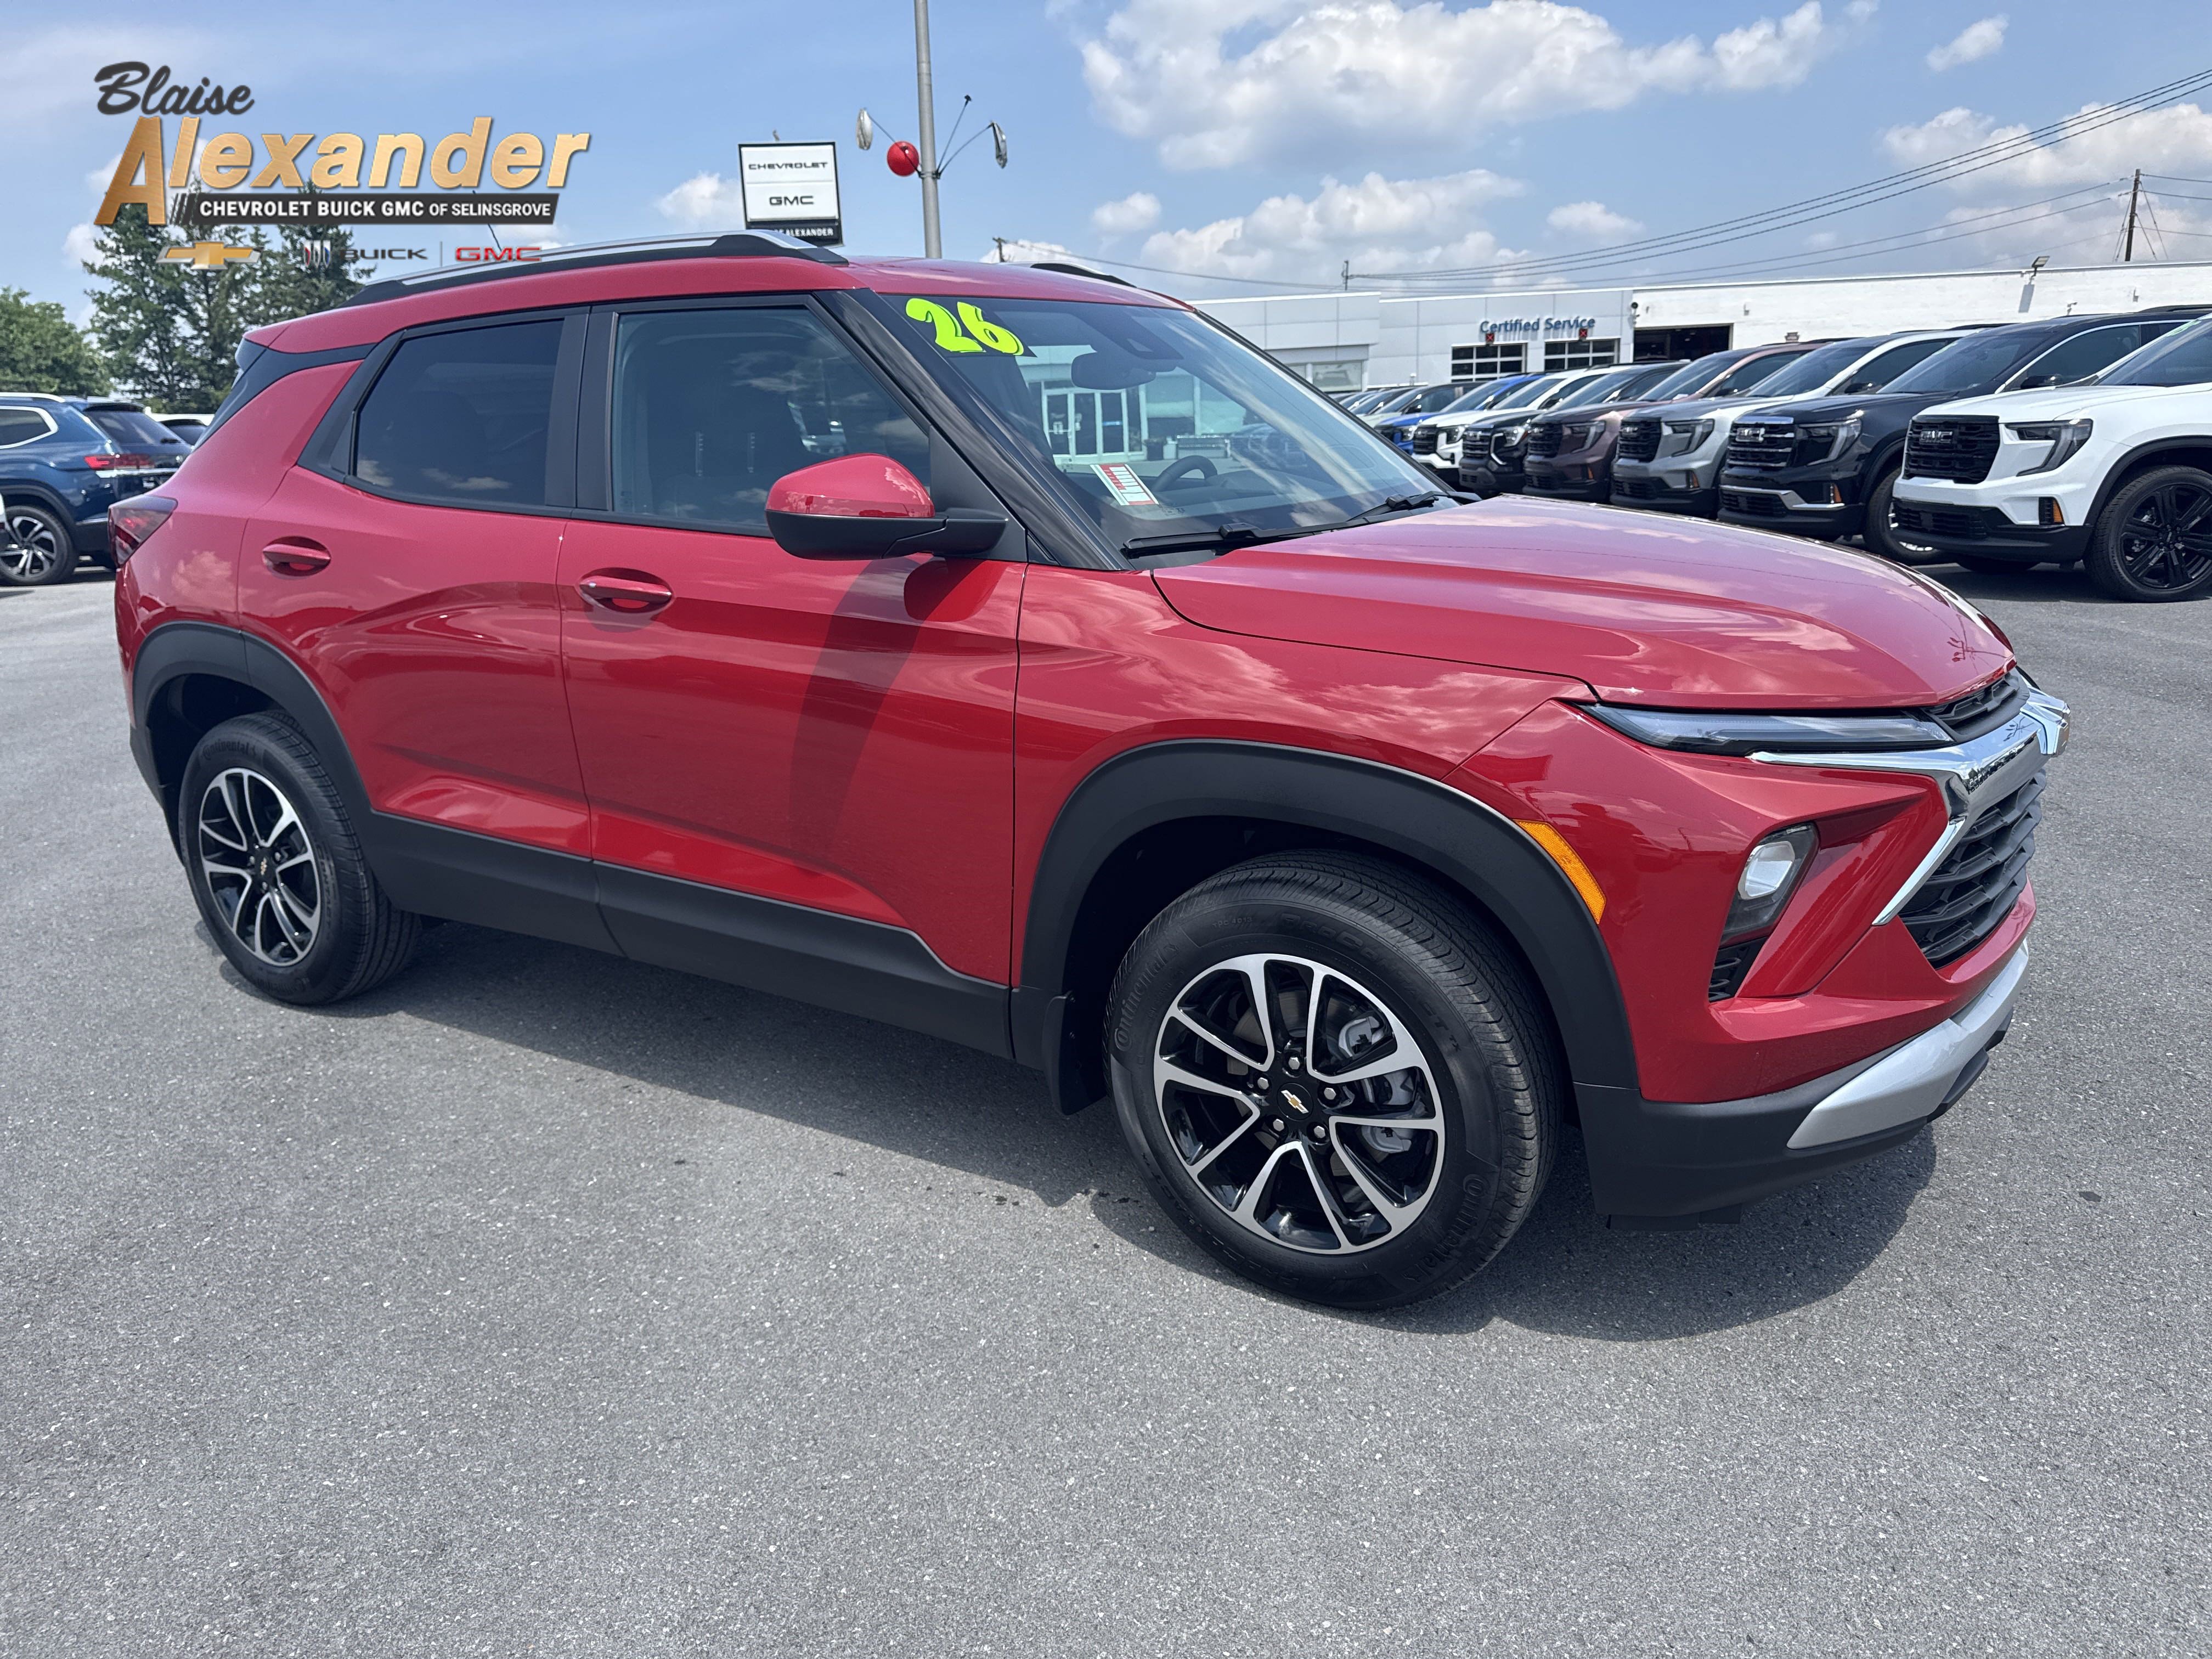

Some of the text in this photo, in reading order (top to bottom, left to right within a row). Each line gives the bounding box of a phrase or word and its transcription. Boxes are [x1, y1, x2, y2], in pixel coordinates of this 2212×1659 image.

[748, 162, 828, 170] CHEVROLET
[769, 195, 814, 206] GMC
[786, 227, 834, 237] ALEXANDER
[906, 298, 1024, 356] 26
[1480, 316, 1596, 333] Certified Service
[1920, 430, 1953, 443] GMC
